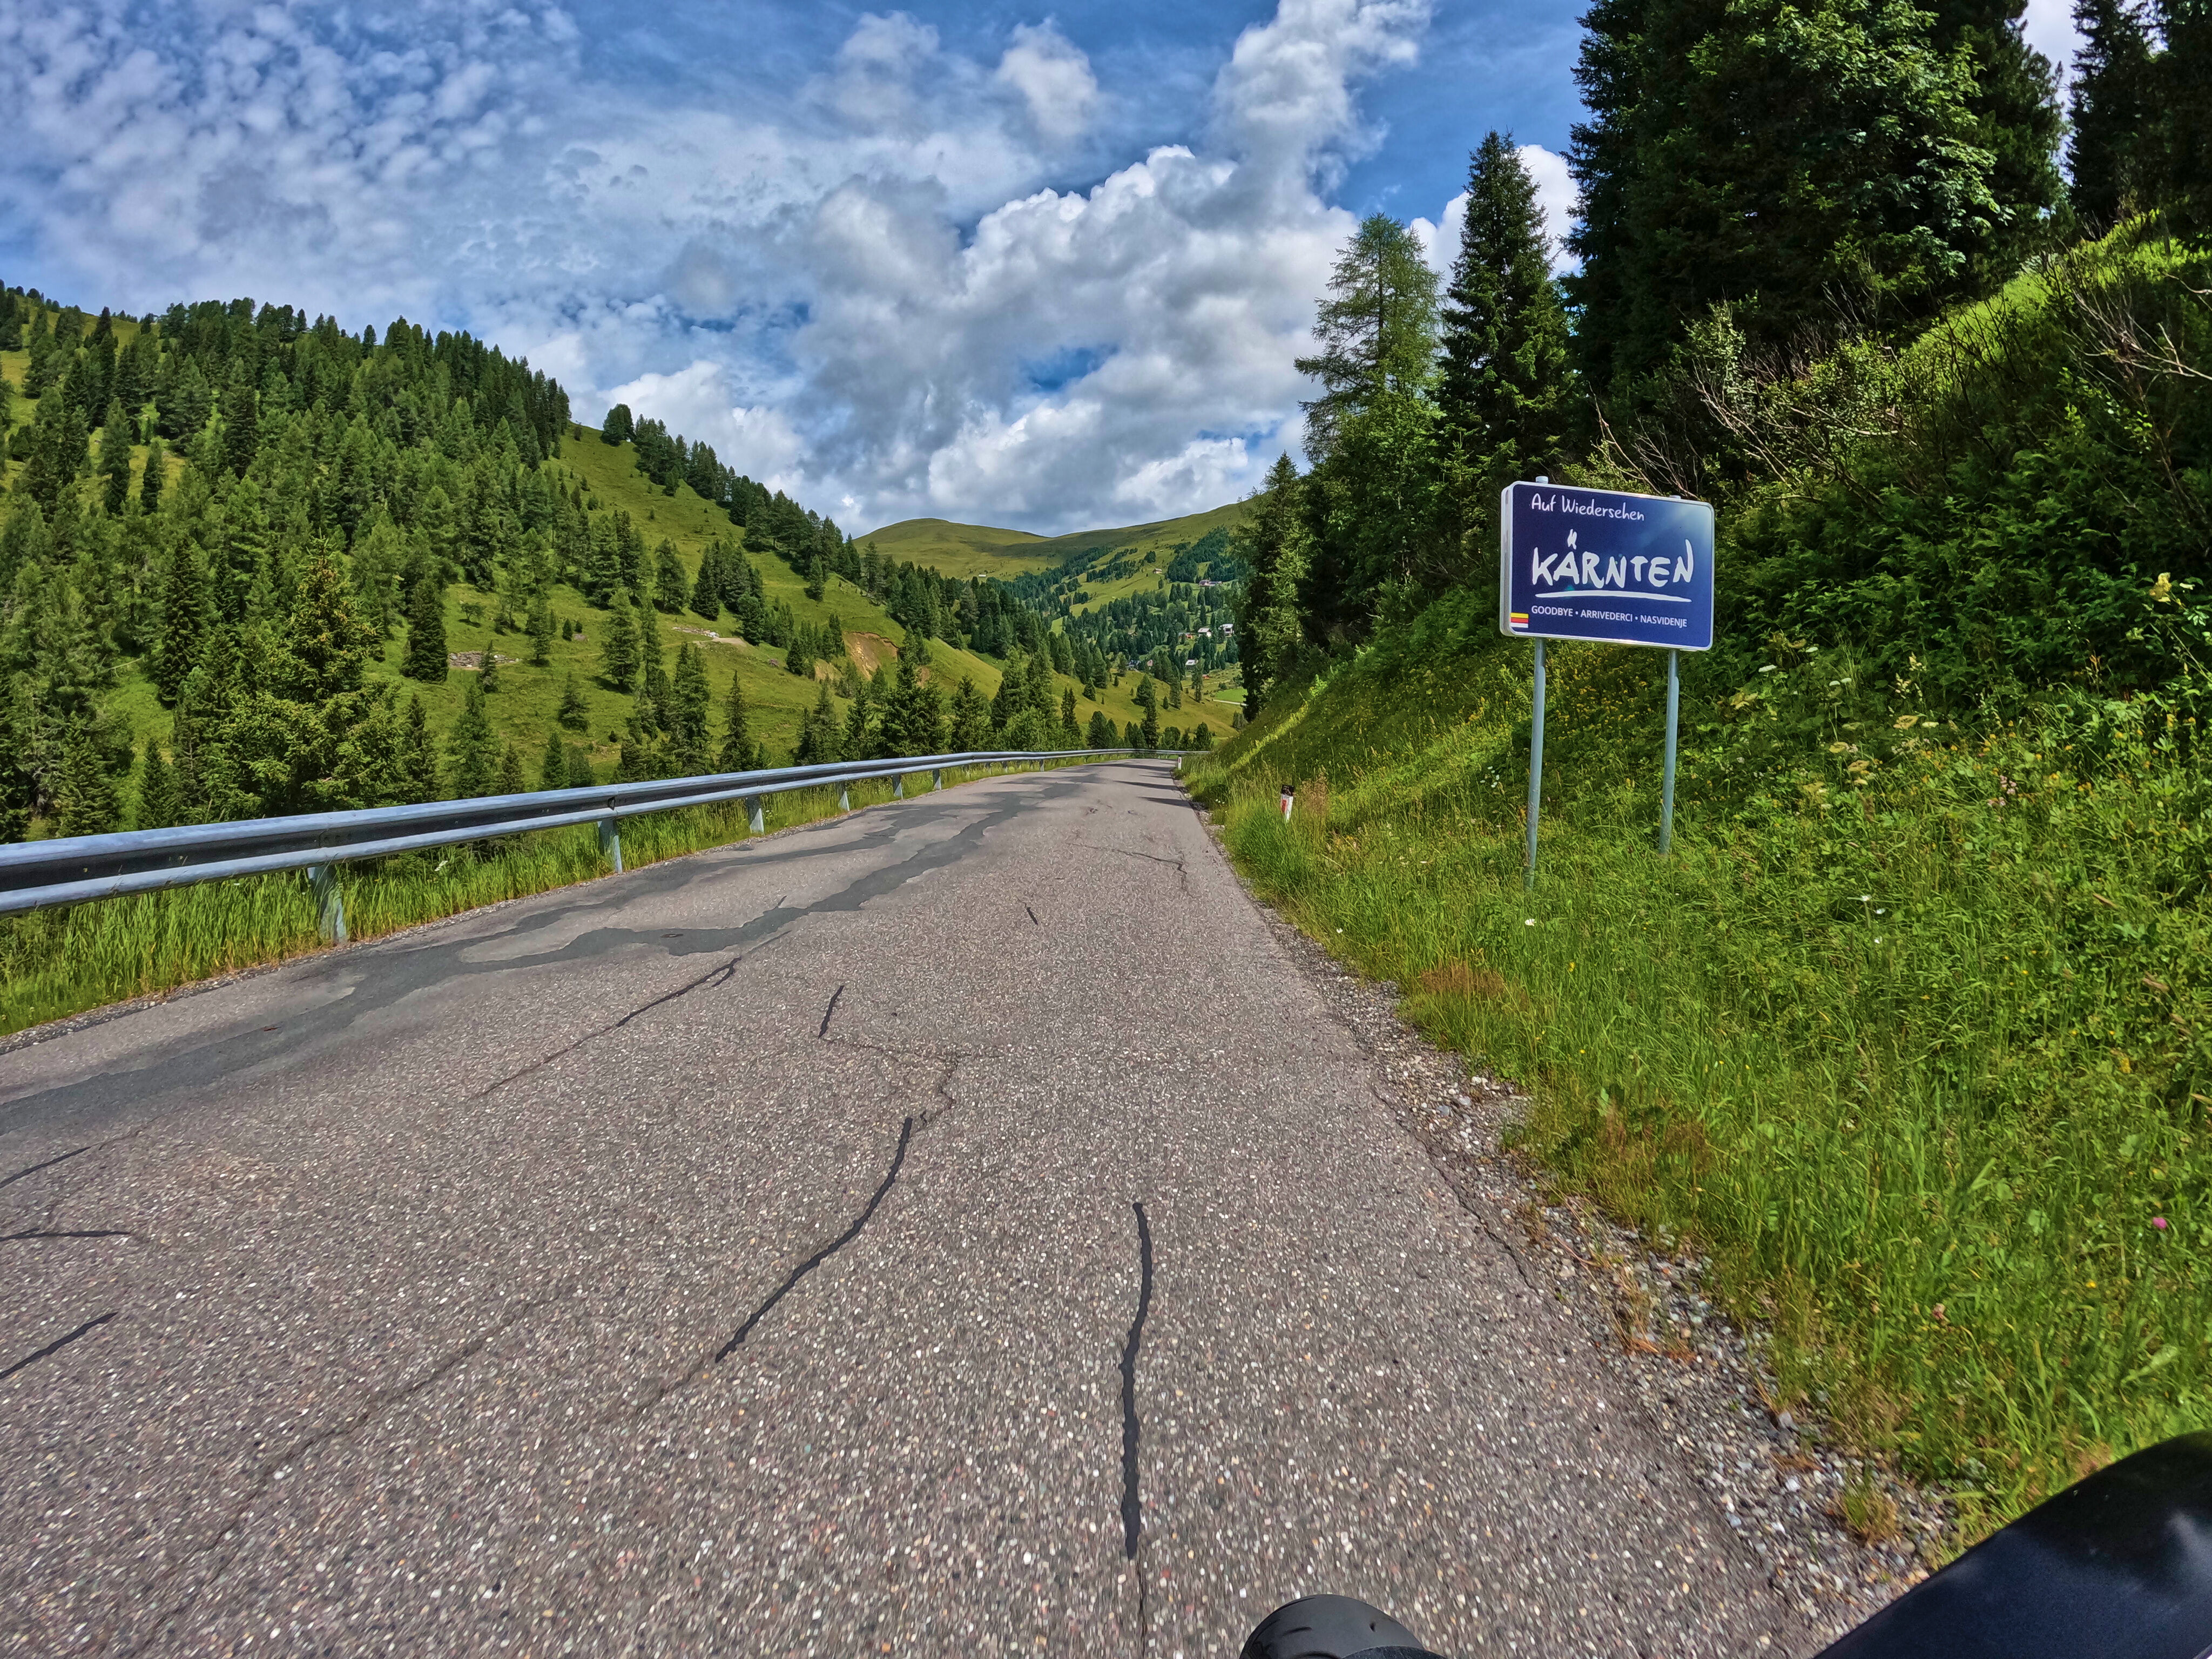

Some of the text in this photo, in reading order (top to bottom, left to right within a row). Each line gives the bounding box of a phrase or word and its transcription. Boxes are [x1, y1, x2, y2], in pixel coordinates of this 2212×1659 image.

[1532, 493, 1644, 521] Auf Wiedersehen
[1532, 529, 1694, 588] KÄRNTEN
[1531, 605, 1687, 628] GOODBYE ARRIVEDERCI NASVIDENJE
